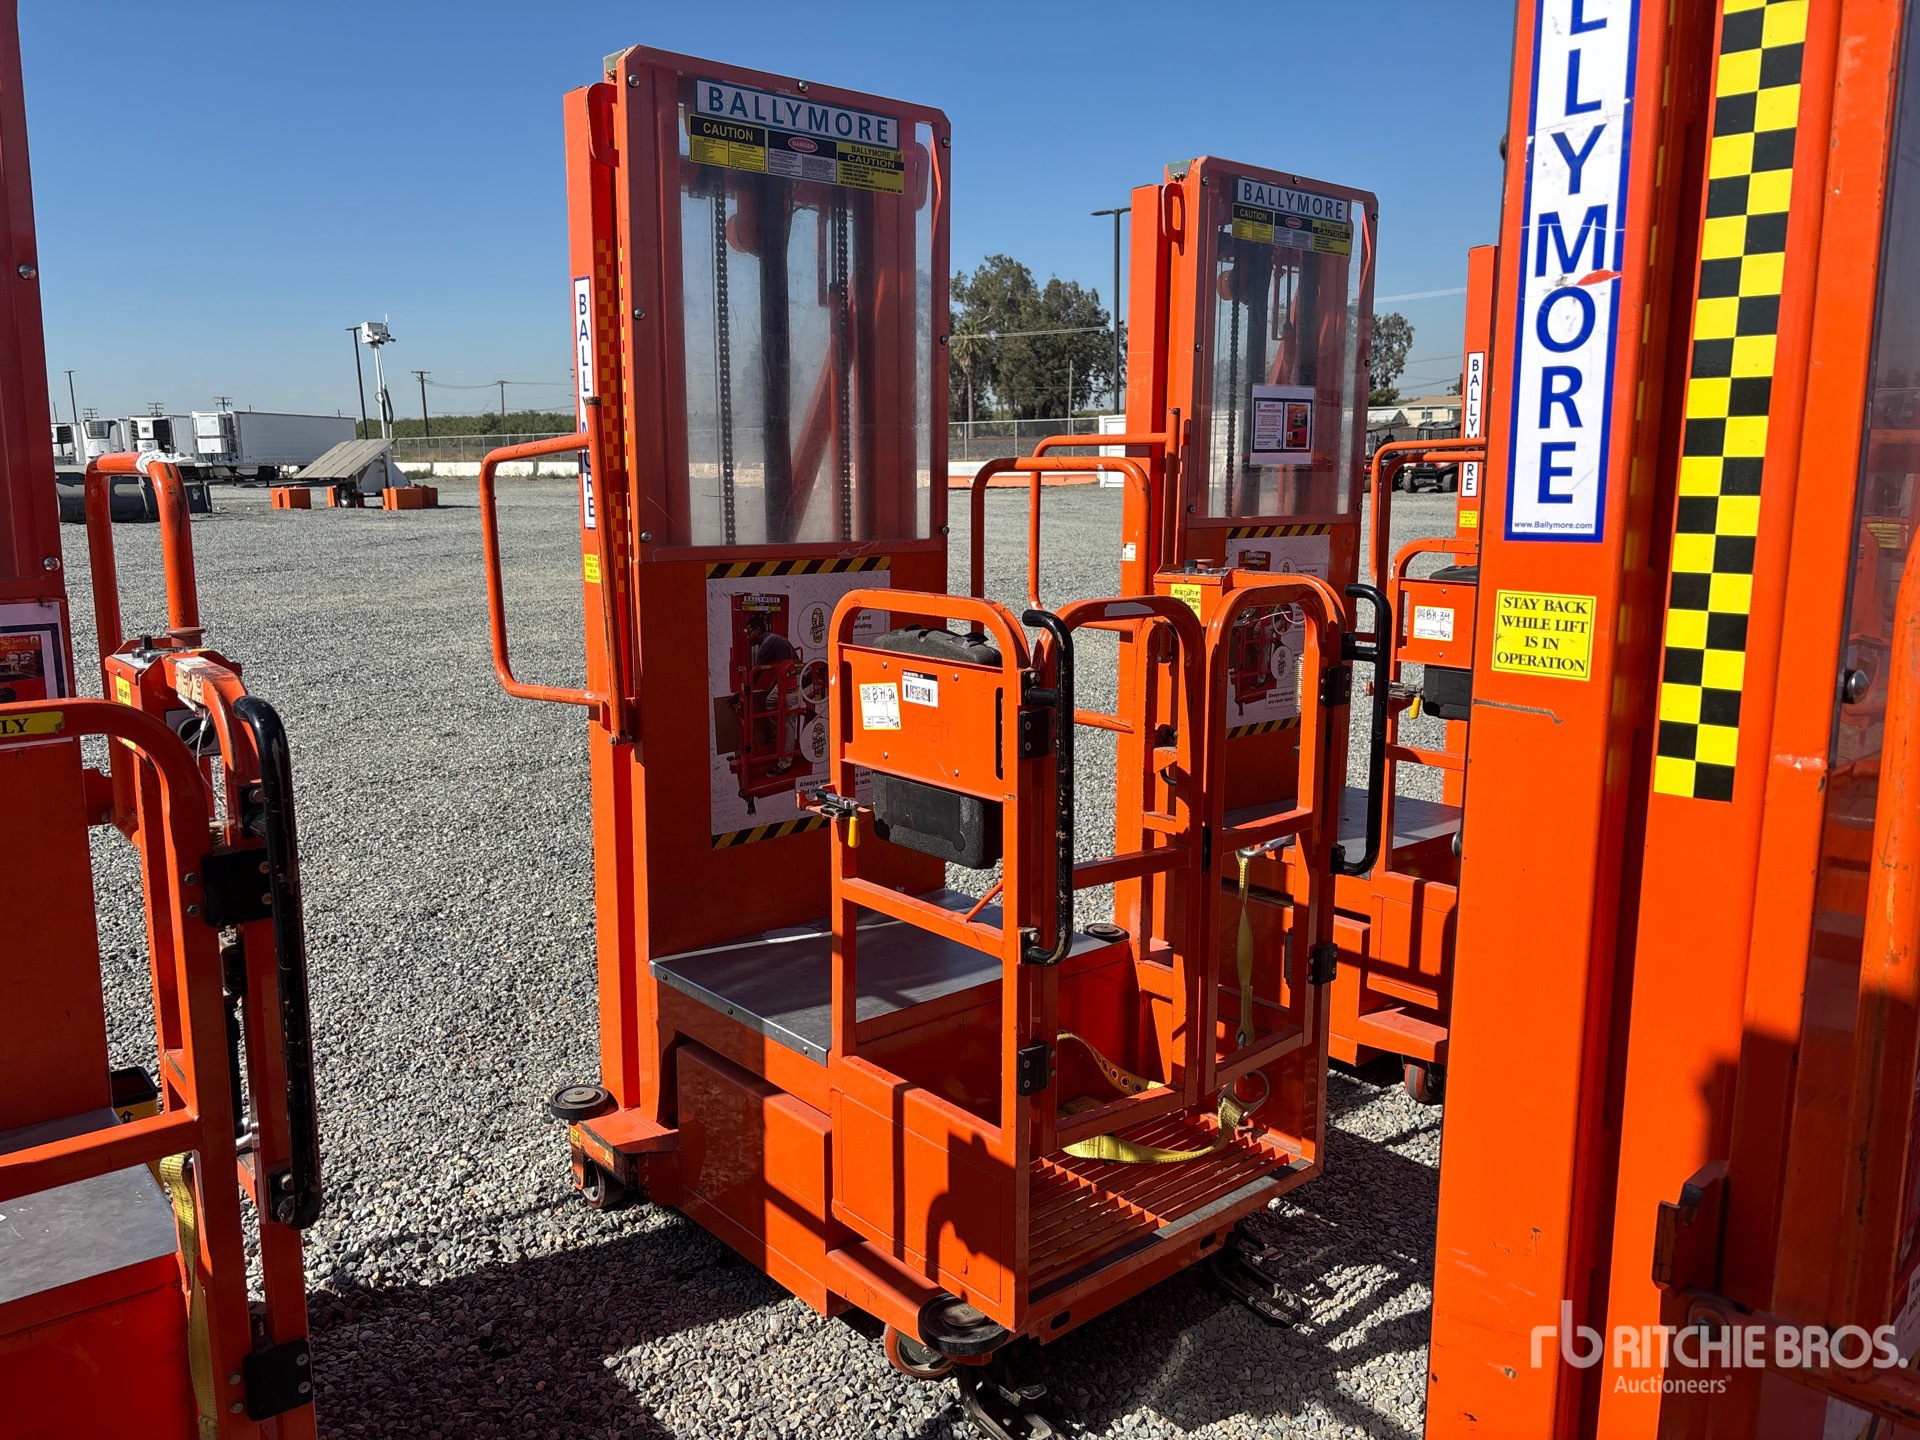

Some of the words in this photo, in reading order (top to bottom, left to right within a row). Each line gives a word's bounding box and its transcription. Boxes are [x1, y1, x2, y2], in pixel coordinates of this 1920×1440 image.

[708, 85, 889, 144] BALLYMORE
[702, 122, 754, 141] CAUTION
[851, 145, 891, 159] BALLYMORE
[847, 154, 895, 169] CAUTION
[1243, 182, 1343, 219] BALLYMORE
[1239, 208, 1267, 221] CAUTION
[1317, 228, 1346, 238] CAUTION
[1513, 521, 1593, 531] www.Ballymore.com
[1503, 596, 1540, 611] STAY
[1543, 599, 1588, 615] BACK
[1500, 614, 1551, 631] WHILE
[1555, 619, 1588, 634] LIFT
[1524, 635, 1539, 648] IS
[1542, 637, 1560, 651] IN
[1496, 651, 1586, 673] OPERATION
[799, 779, 819, 787] Always
